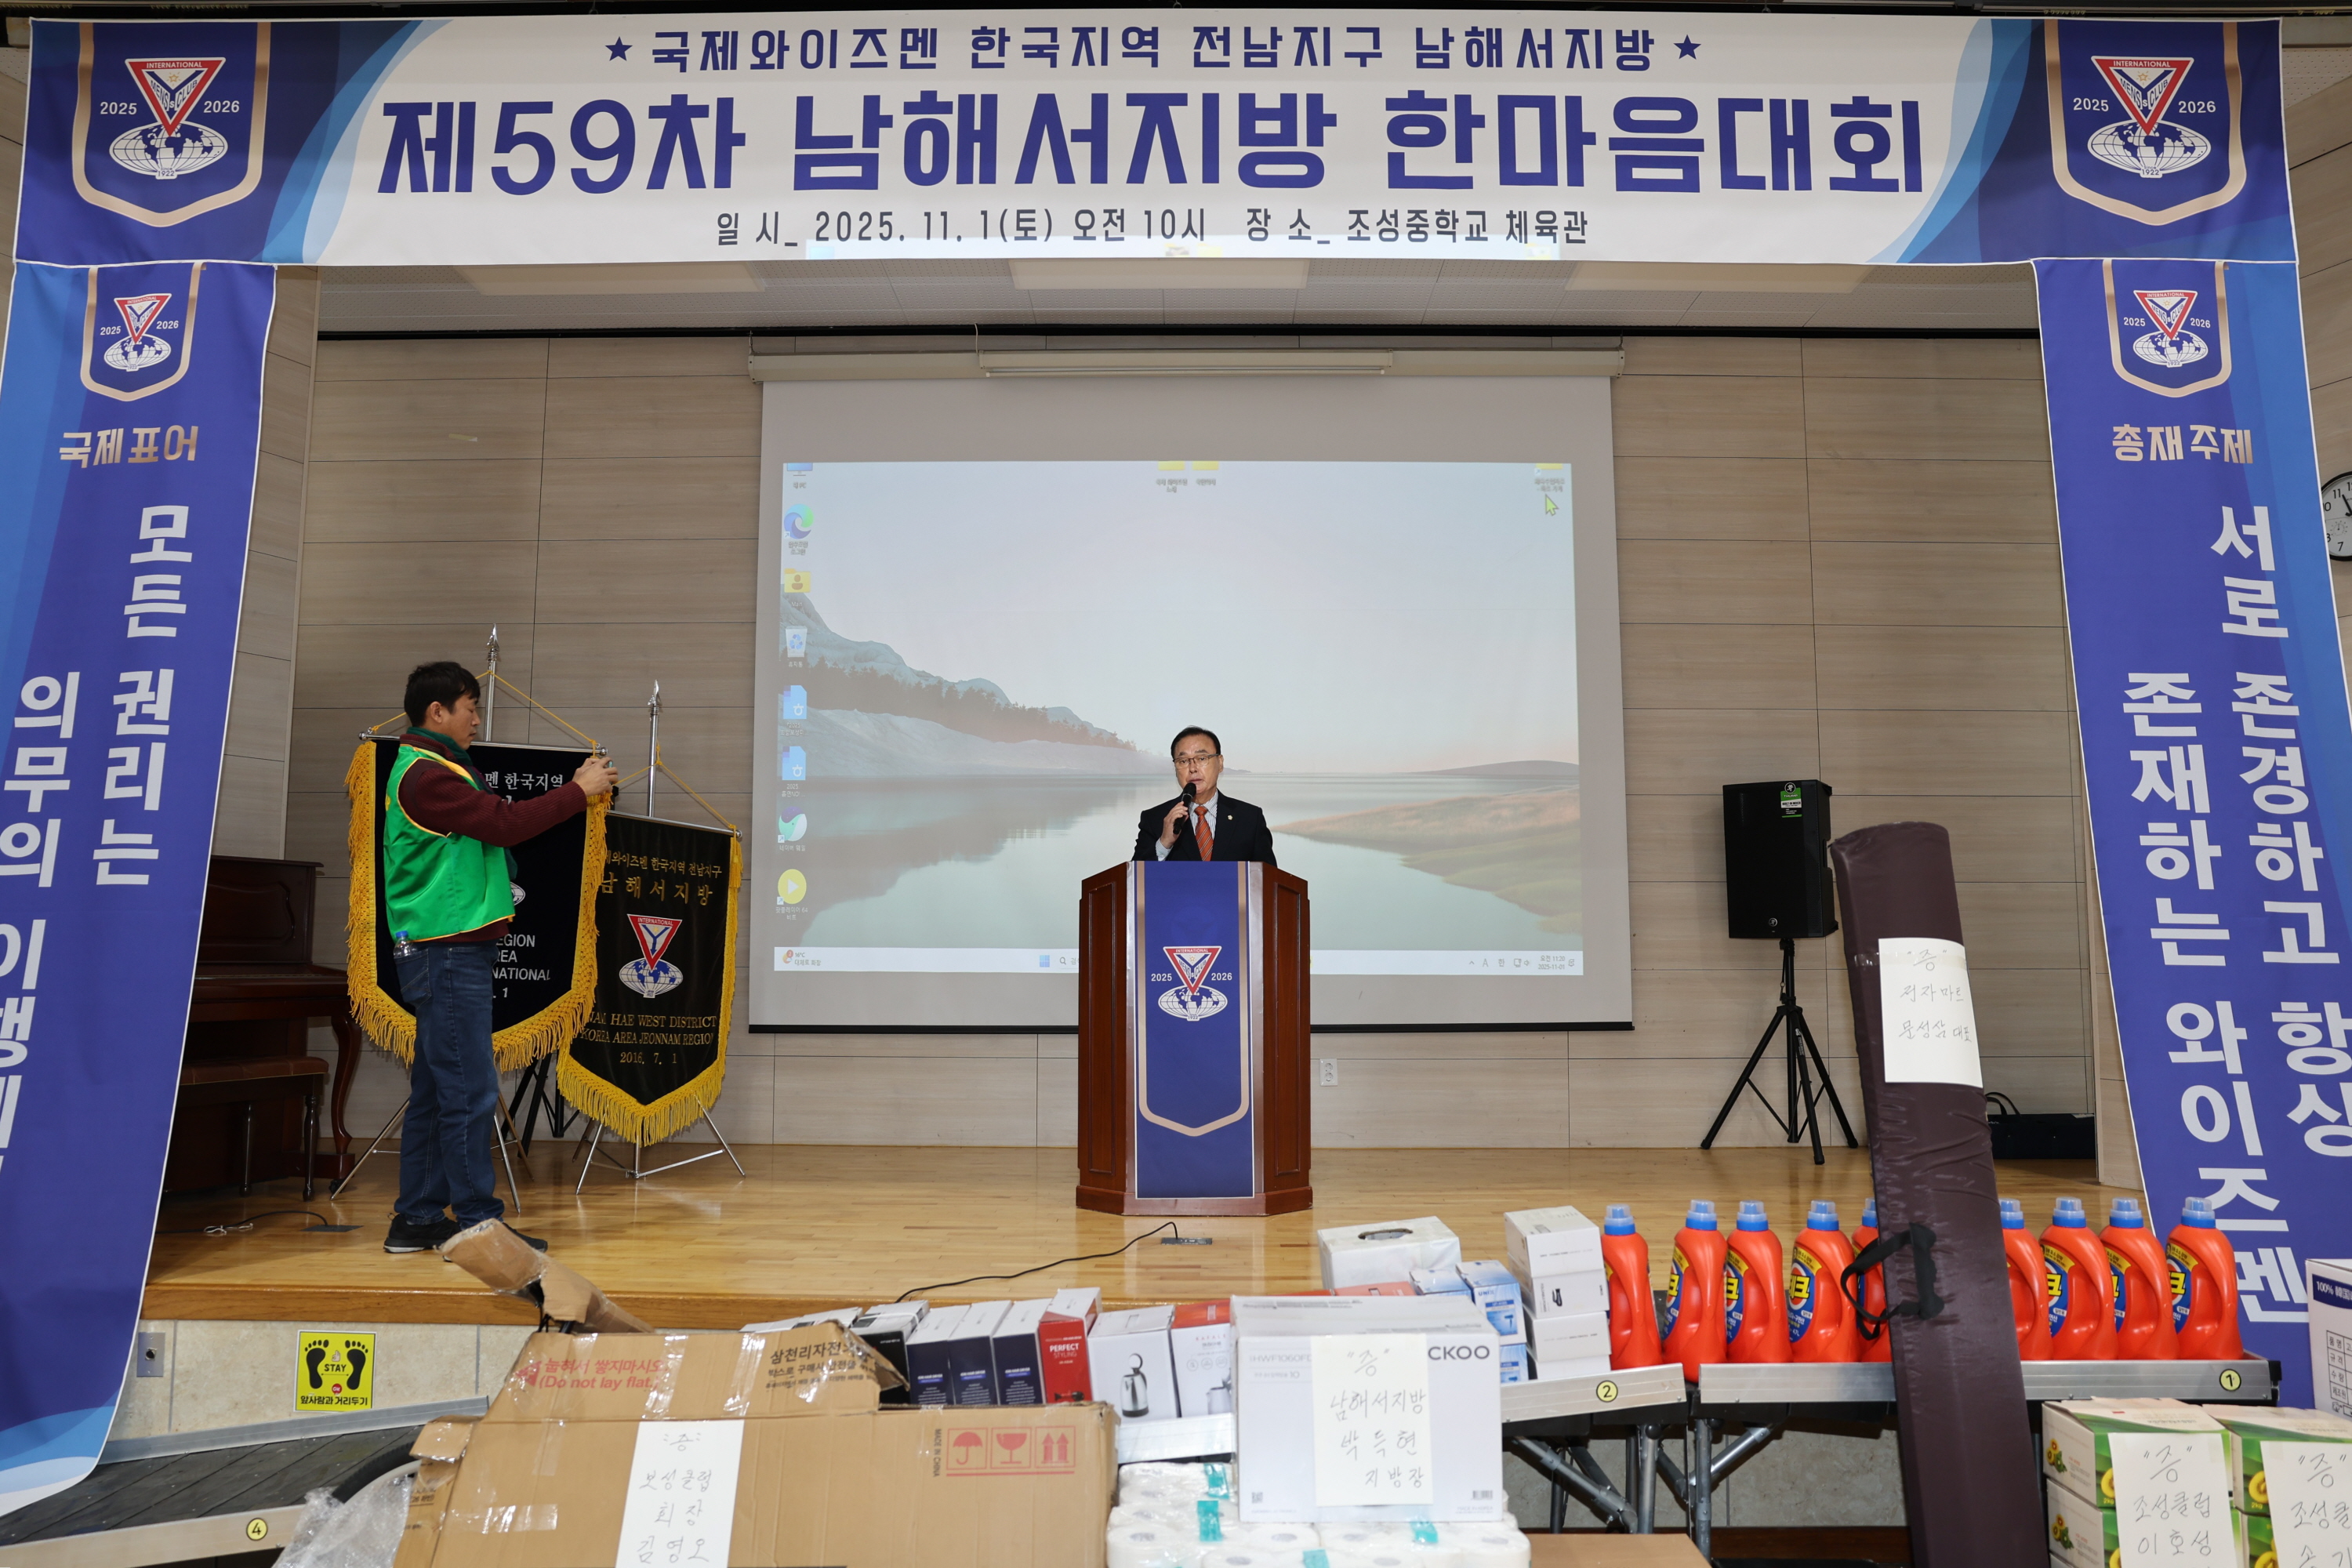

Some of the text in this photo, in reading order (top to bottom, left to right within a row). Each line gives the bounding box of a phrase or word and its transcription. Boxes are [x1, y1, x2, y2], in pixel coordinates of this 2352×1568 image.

[652, 26, 1655, 73] 국제와이즈멘 한국지역 전남지구 남해서지방
[100, 102, 137, 114] 2025
[204, 100, 240, 113] 2026
[2074, 98, 2109, 111] 2025
[2179, 101, 2216, 113] 2026
[377, 90, 1922, 195] 제59차 남해서지방 한마음대회
[1073, 209, 1126, 241] 오전
[1144, 209, 1205, 241] 10시
[1347, 209, 1488, 244] 조성중학교
[1505, 210, 1588, 245] 체육관
[157, 321, 179, 329] 2026
[2124, 318, 2146, 326] 2025
[2190, 318, 2211, 328] 2026
[100, 326, 122, 335] 2025
[59, 425, 199, 468] 국제 표어
[2112, 424, 2253, 464] 총재 주제
[2333, 488, 2341, 499] 11
[2337, 541, 2344, 552] 7
[2210, 506, 2289, 638] 서로
[93, 506, 193, 885] 모든 권리는
[0, 672, 80, 887] 의무의
[505, 772, 564, 791] 한국지역
[2231, 672, 2340, 964] 존경하고
[651, 857, 685, 875] 한국지역
[688, 863, 722, 879] 전남지구
[637, 917, 673, 926] INTERNATIONAL
[495, 934, 535, 947] EGION
[492, 967, 550, 981] NATIONAL
[2123, 673, 2310, 1323] 존재하는 와이즈멘
[610, 1013, 634, 1026] HAE
[637, 1014, 666, 1027] WEST
[669, 1016, 717, 1029] DISTRICT
[612, 1033, 637, 1044] AREA
[640, 1033, 681, 1045] JEONNAM
[1668, 1273, 1679, 1296] 크
[1727, 1276, 1739, 1300] 크
[2047, 1273, 2062, 1296] 크
[2169, 1272, 2186, 1294] 크
[2316, 1280, 2333, 1295] 100%
[770, 1342, 855, 1364] 삼천리자전
[1050, 1343, 1079, 1352] PERFECT
[325, 1363, 347, 1372] STAY
[545, 1358, 590, 1374] 눕혀서
[539, 1375, 566, 1389] (Do
[571, 1377, 595, 1388] not
[600, 1377, 622, 1392] lay
[2226, 1374, 2233, 1387] 1
[1602, 1385, 1613, 1398] 2
[300, 1396, 368, 1406] 앞사람과 거리두기
[252, 1522, 261, 1536] 4
